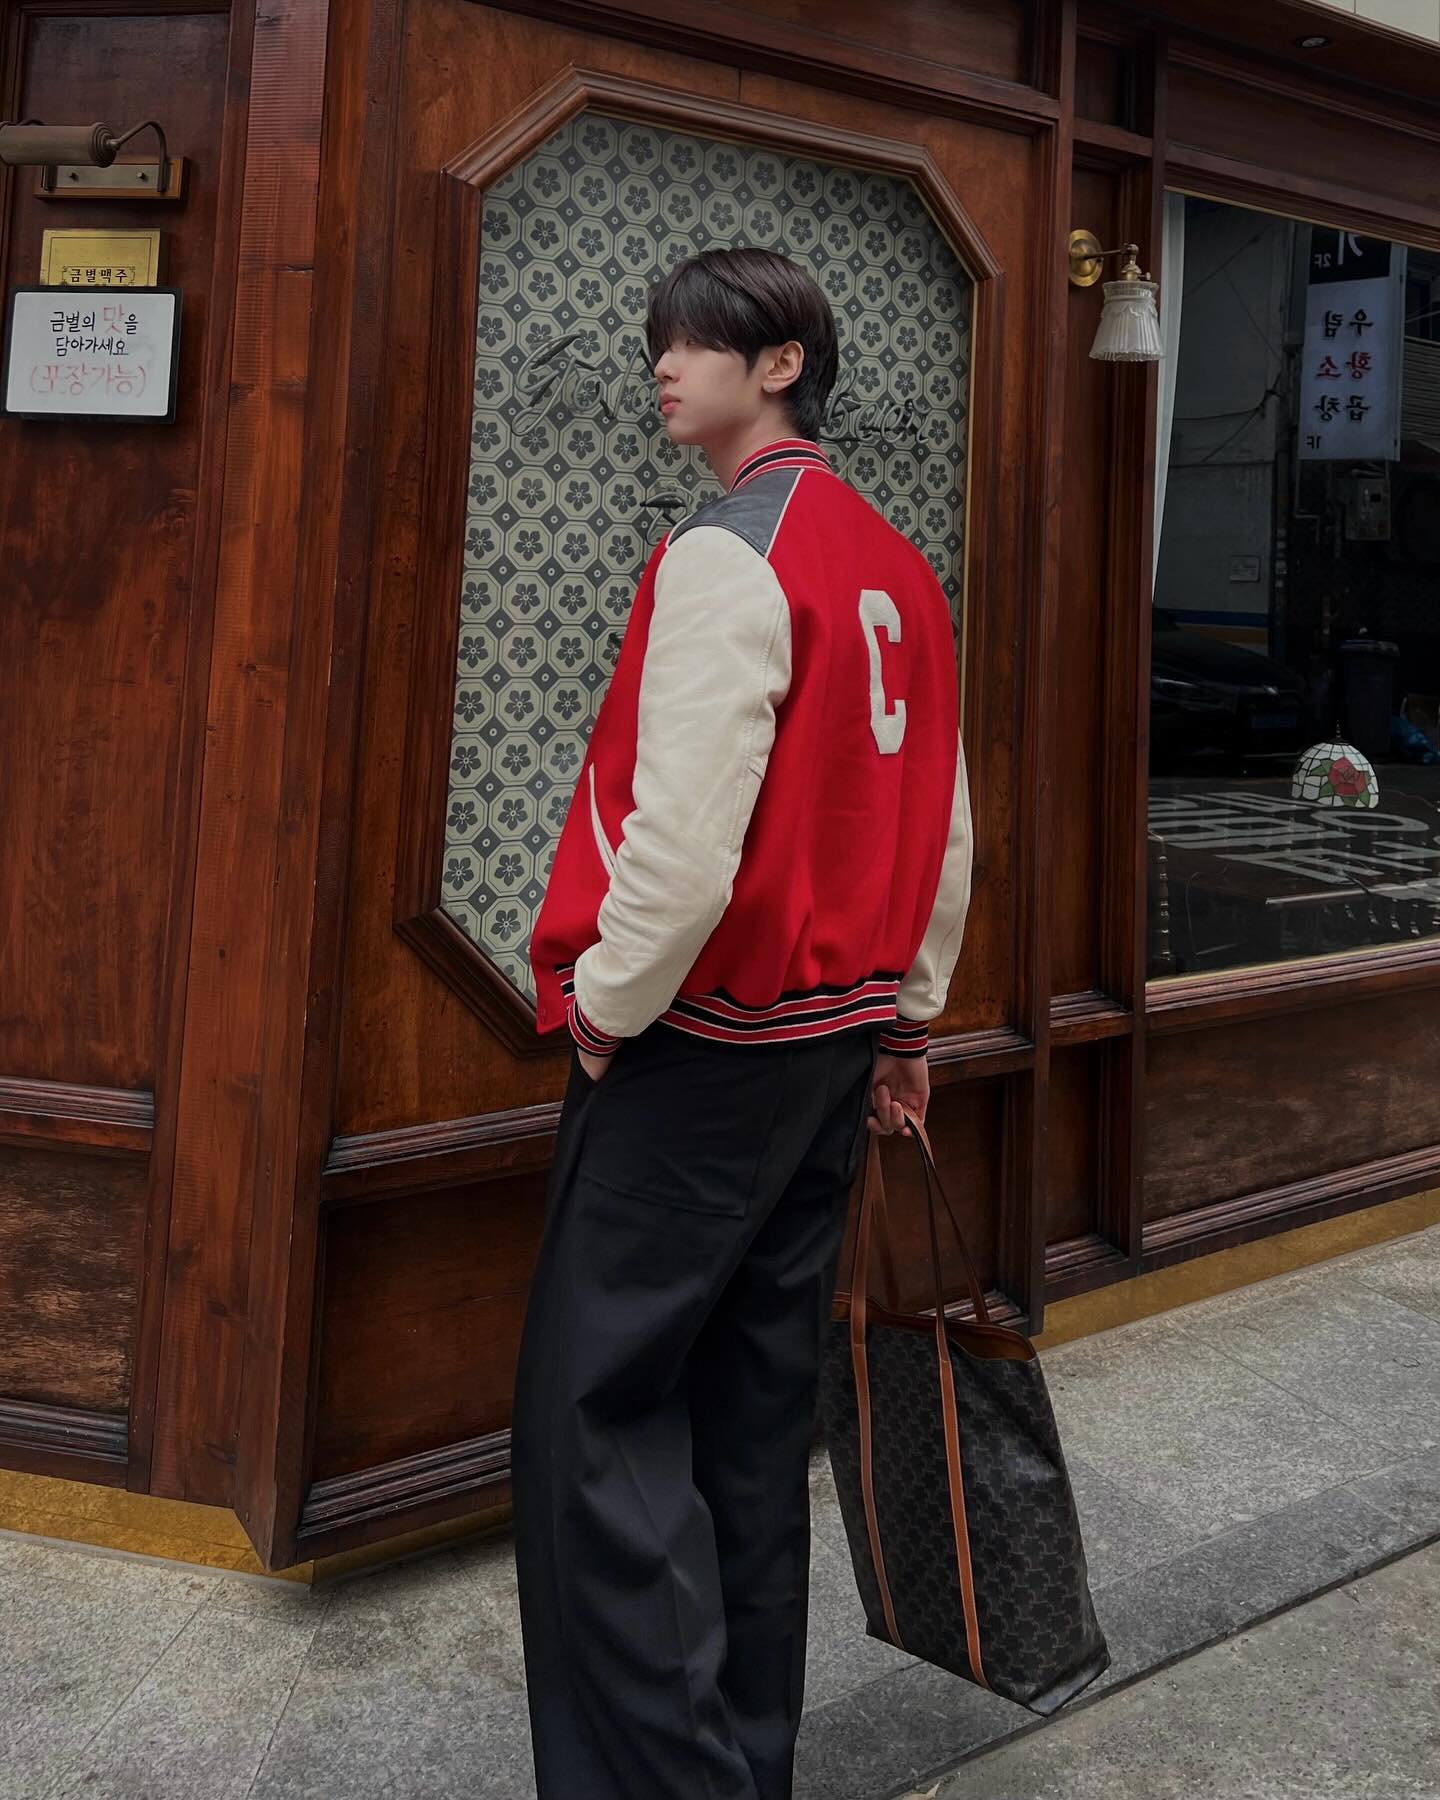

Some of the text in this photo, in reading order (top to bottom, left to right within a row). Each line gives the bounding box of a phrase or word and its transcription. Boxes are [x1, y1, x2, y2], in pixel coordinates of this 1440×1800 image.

[69, 268, 128, 283] 금별맥주
[50, 304, 139, 335] 금별의 맛을
[56, 336, 129, 357] 담아가세요
[858, 589, 907, 755] C
